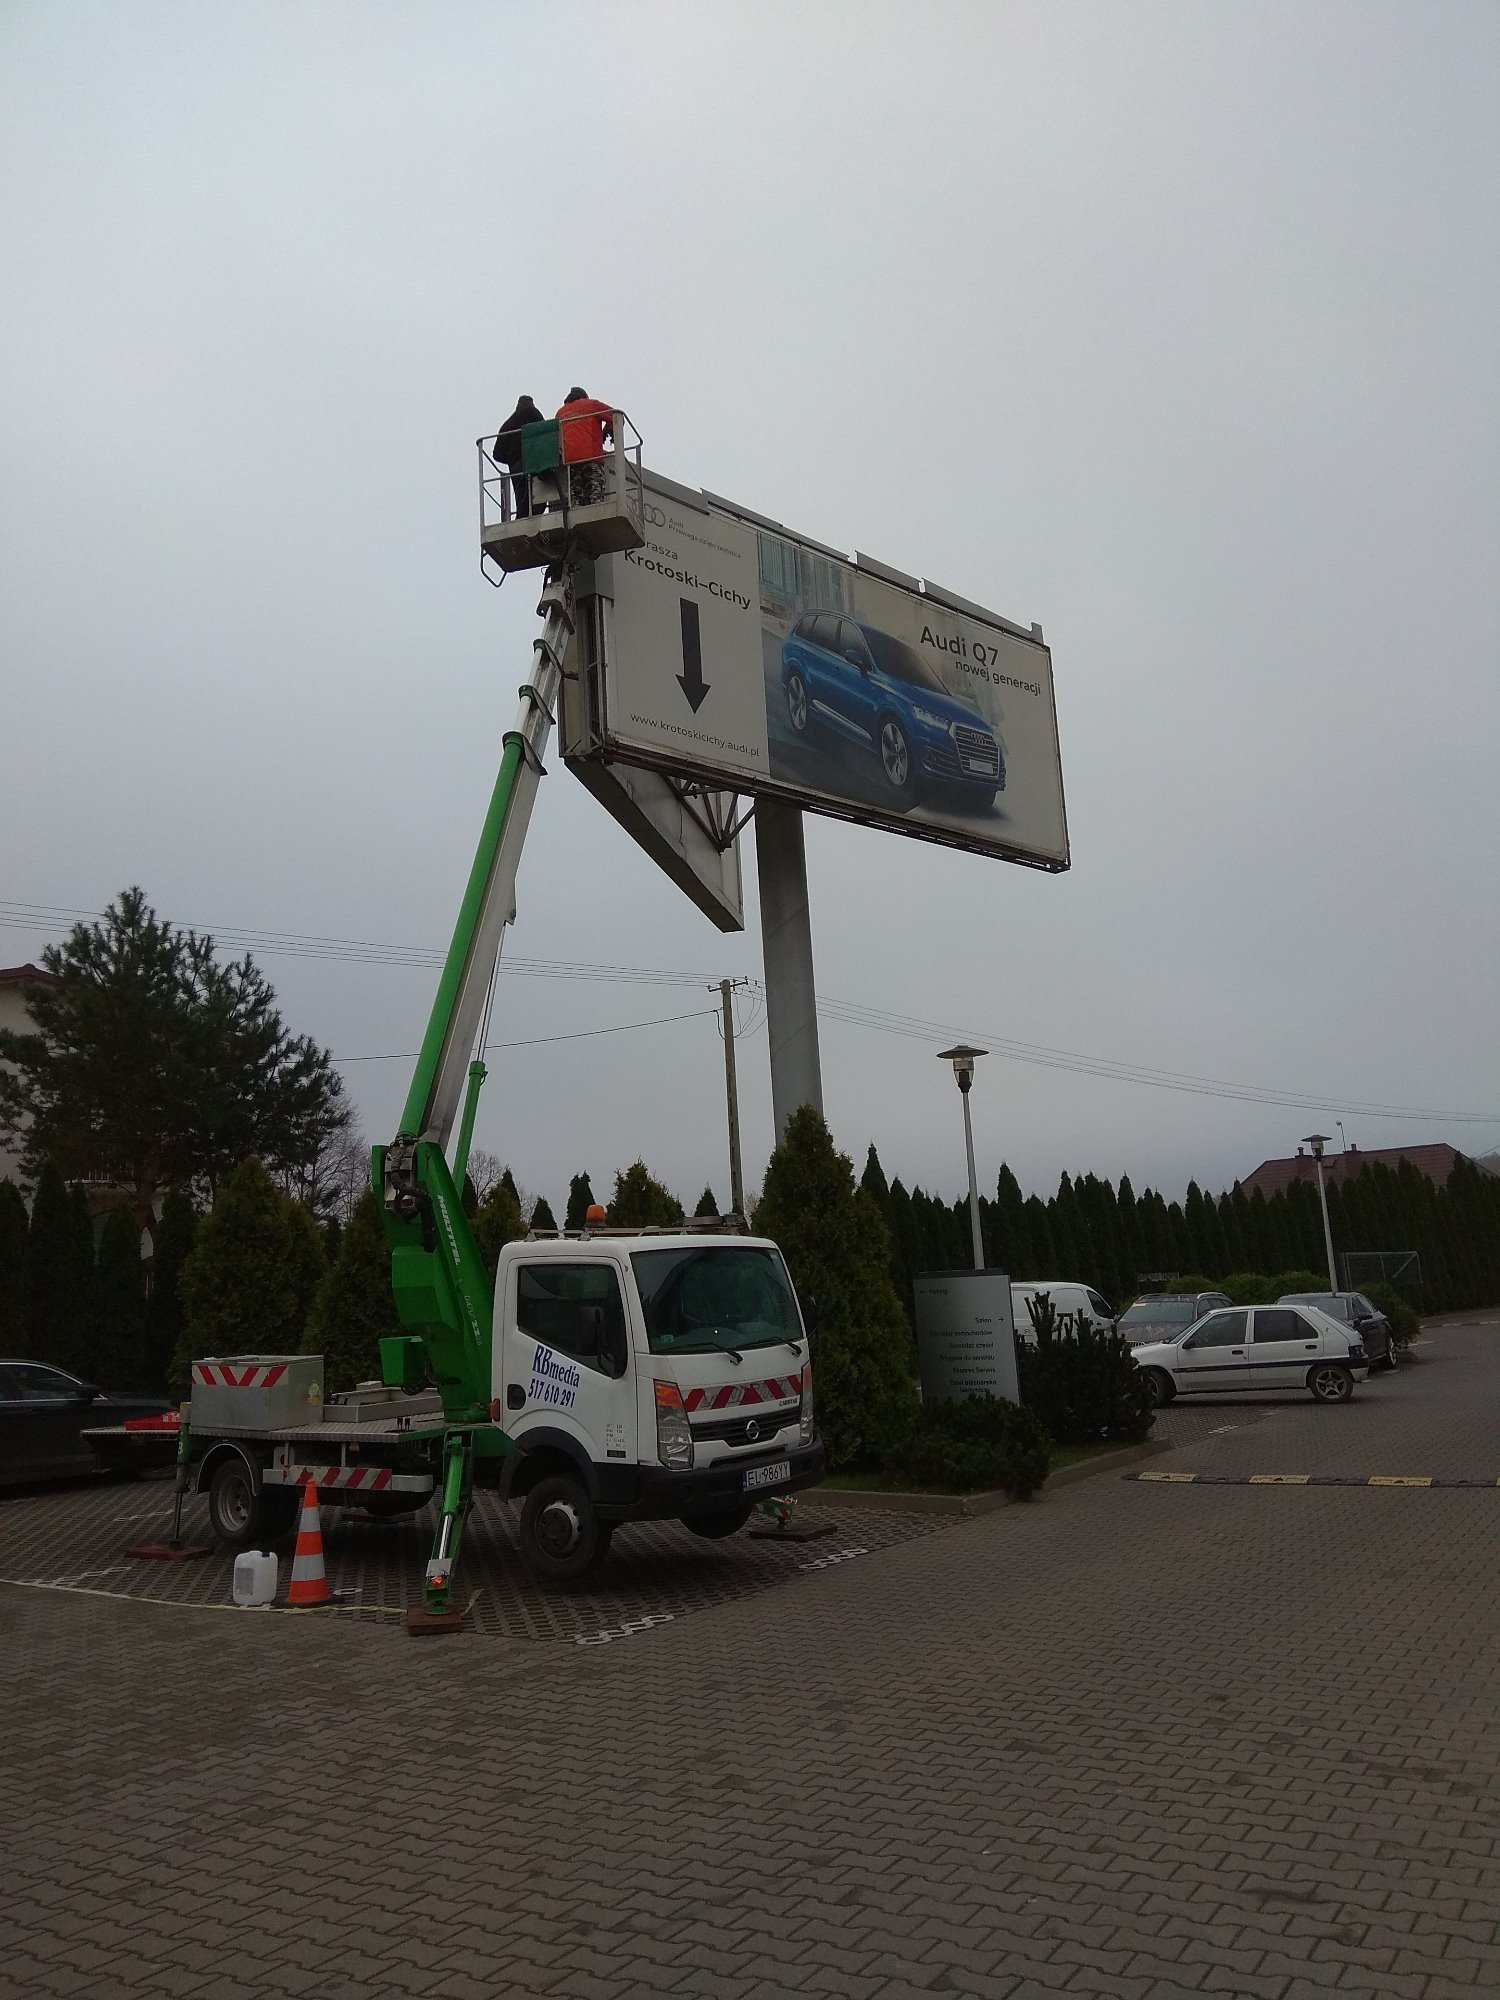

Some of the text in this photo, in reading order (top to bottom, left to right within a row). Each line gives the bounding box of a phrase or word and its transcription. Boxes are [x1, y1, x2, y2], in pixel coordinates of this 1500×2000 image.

[668, 518, 684, 528] Audi
[646, 540, 679, 561] rasza
[920, 625, 999, 667] Audi Q7
[955, 661, 1041, 697] nowej generacji
[629, 713, 760, 757] www.krotoskicichy.audi.pl
[437, 1194, 461, 1266] MULTITEL
[531, 1344, 580, 1388] RBmedia
[528, 1378, 576, 1408] 517 610 291
[748, 1462, 789, 1486] EL 986YY
